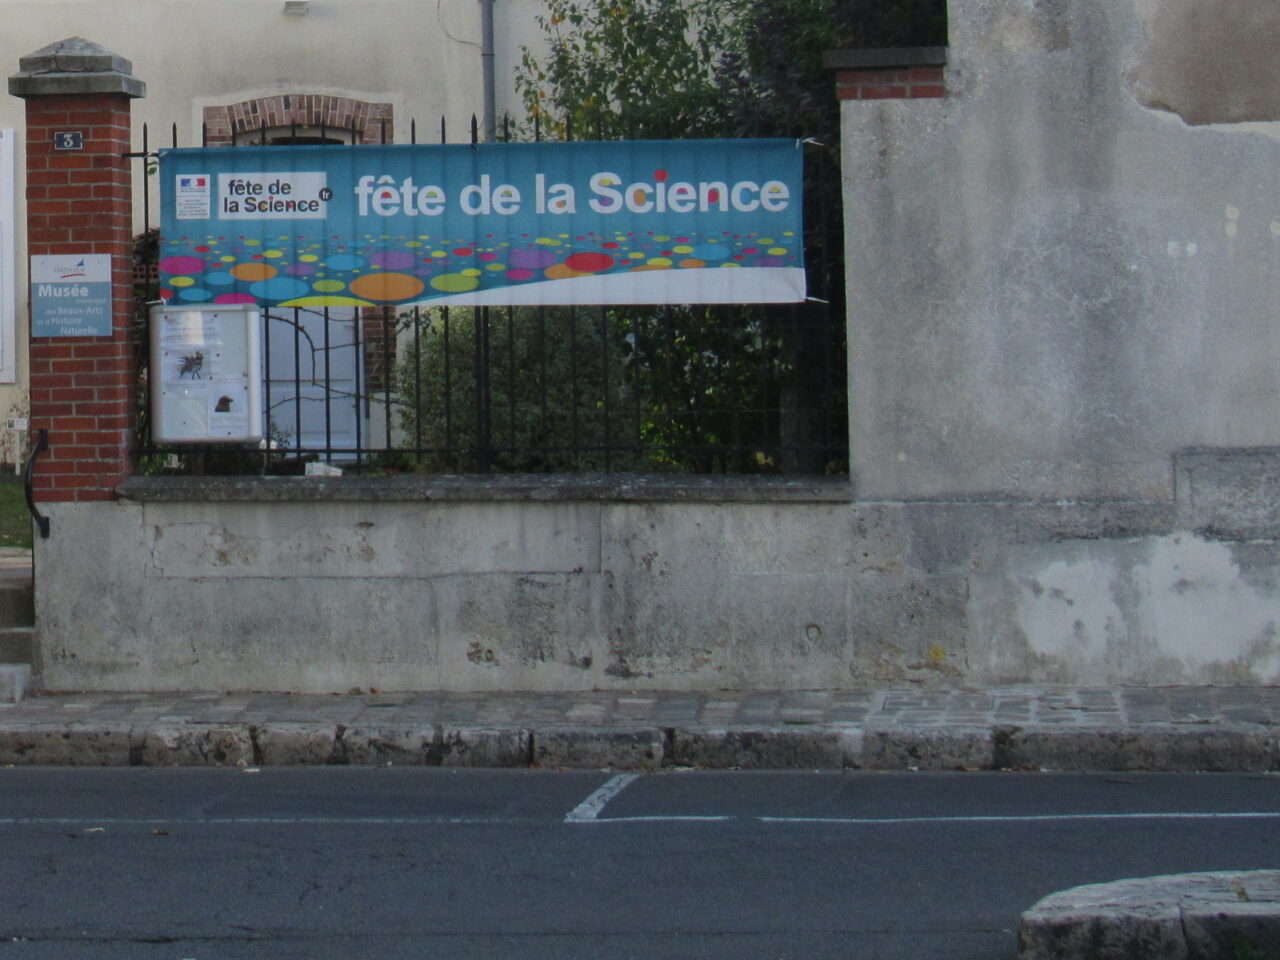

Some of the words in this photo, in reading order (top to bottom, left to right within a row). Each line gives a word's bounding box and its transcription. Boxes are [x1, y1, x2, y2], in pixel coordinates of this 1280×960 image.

[63, 133, 74, 148] 3
[228, 179, 263, 195] fête
[268, 179, 292, 195] de
[354, 175, 446, 217] fête
[459, 174, 521, 217] de
[535, 173, 576, 214] la
[588, 168, 790, 214] Science
[224, 197, 239, 213] la
[244, 196, 320, 213] Science
[38, 283, 89, 297] Musée
[57, 306, 104, 315] Beaux-Arts
[60, 325, 98, 335] Naturelle
